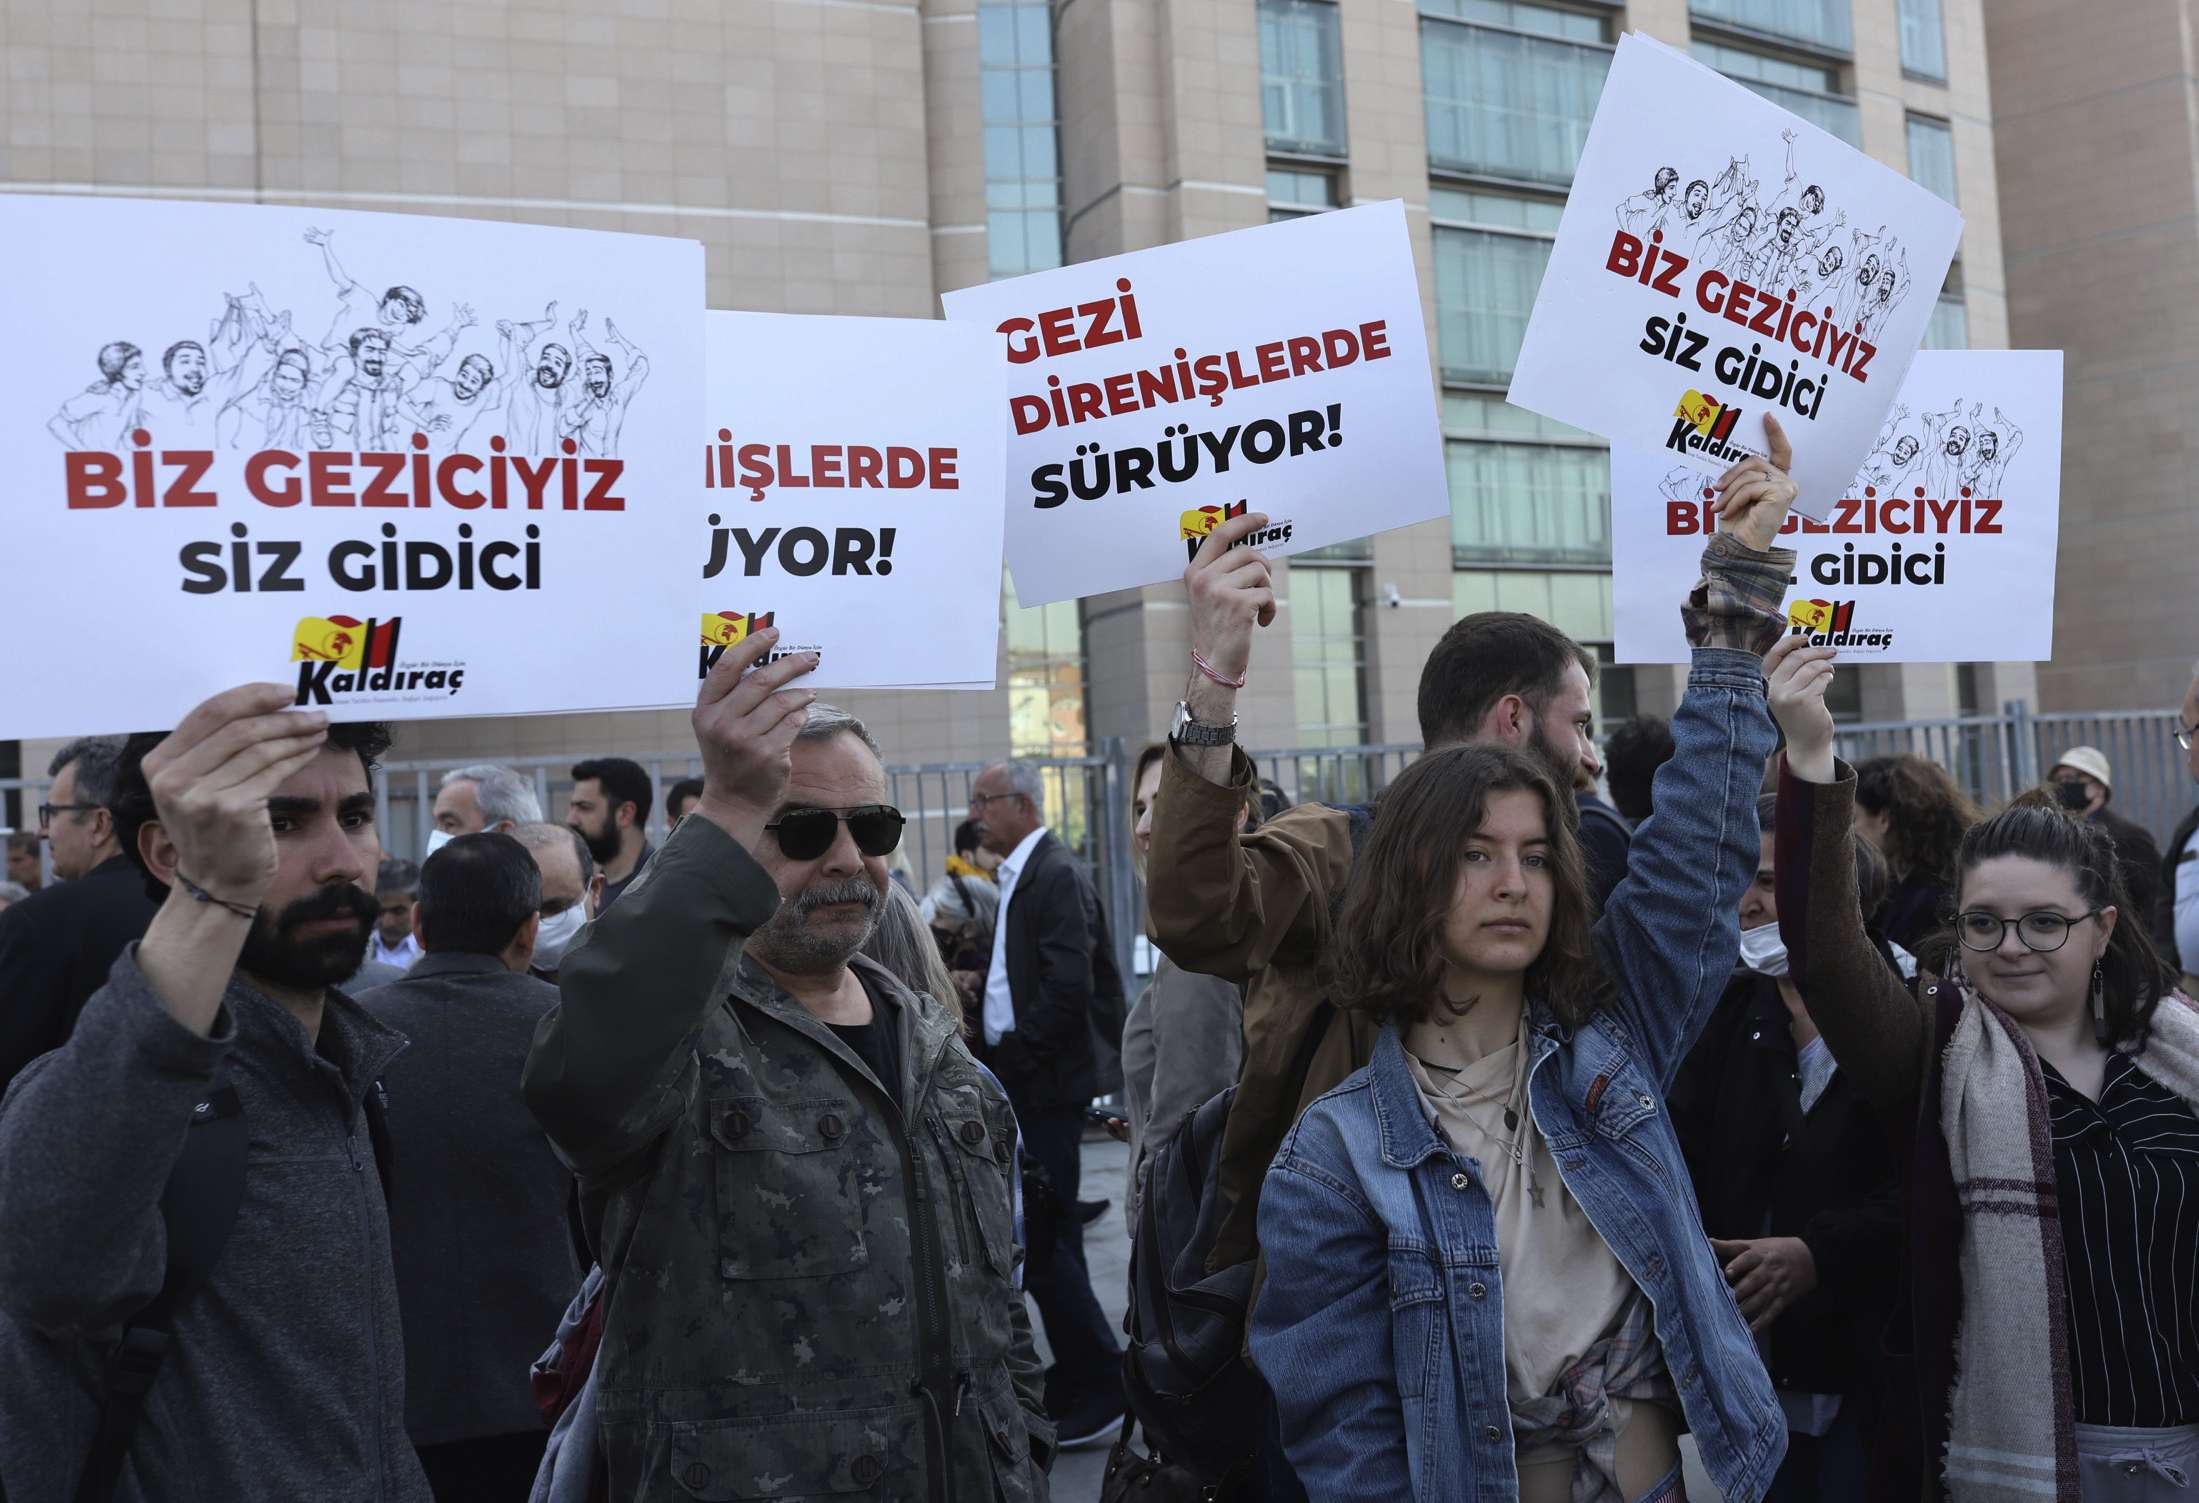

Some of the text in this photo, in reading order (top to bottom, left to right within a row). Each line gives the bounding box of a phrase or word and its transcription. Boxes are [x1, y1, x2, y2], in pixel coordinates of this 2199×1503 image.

[996, 277, 1142, 364] GEZİ
[1606, 229, 1877, 383] BİZ GEZİCİYİZ
[1009, 319, 1391, 436] DİRENİŞLERDE
[1639, 311, 1828, 420] SİZ GİDİCİ
[65, 429, 626, 511] BİZ GEZİCİYİZ
[1030, 403, 1343, 509] SÜRÜYOR!
[1666, 403, 1750, 462] Kaldır
[1666, 487, 1715, 535] Bİ
[179, 522, 541, 594] SİZ GİDİCİ
[1810, 542, 1945, 586] GİDİCİ
[294, 616, 465, 706] Kaldıraç
